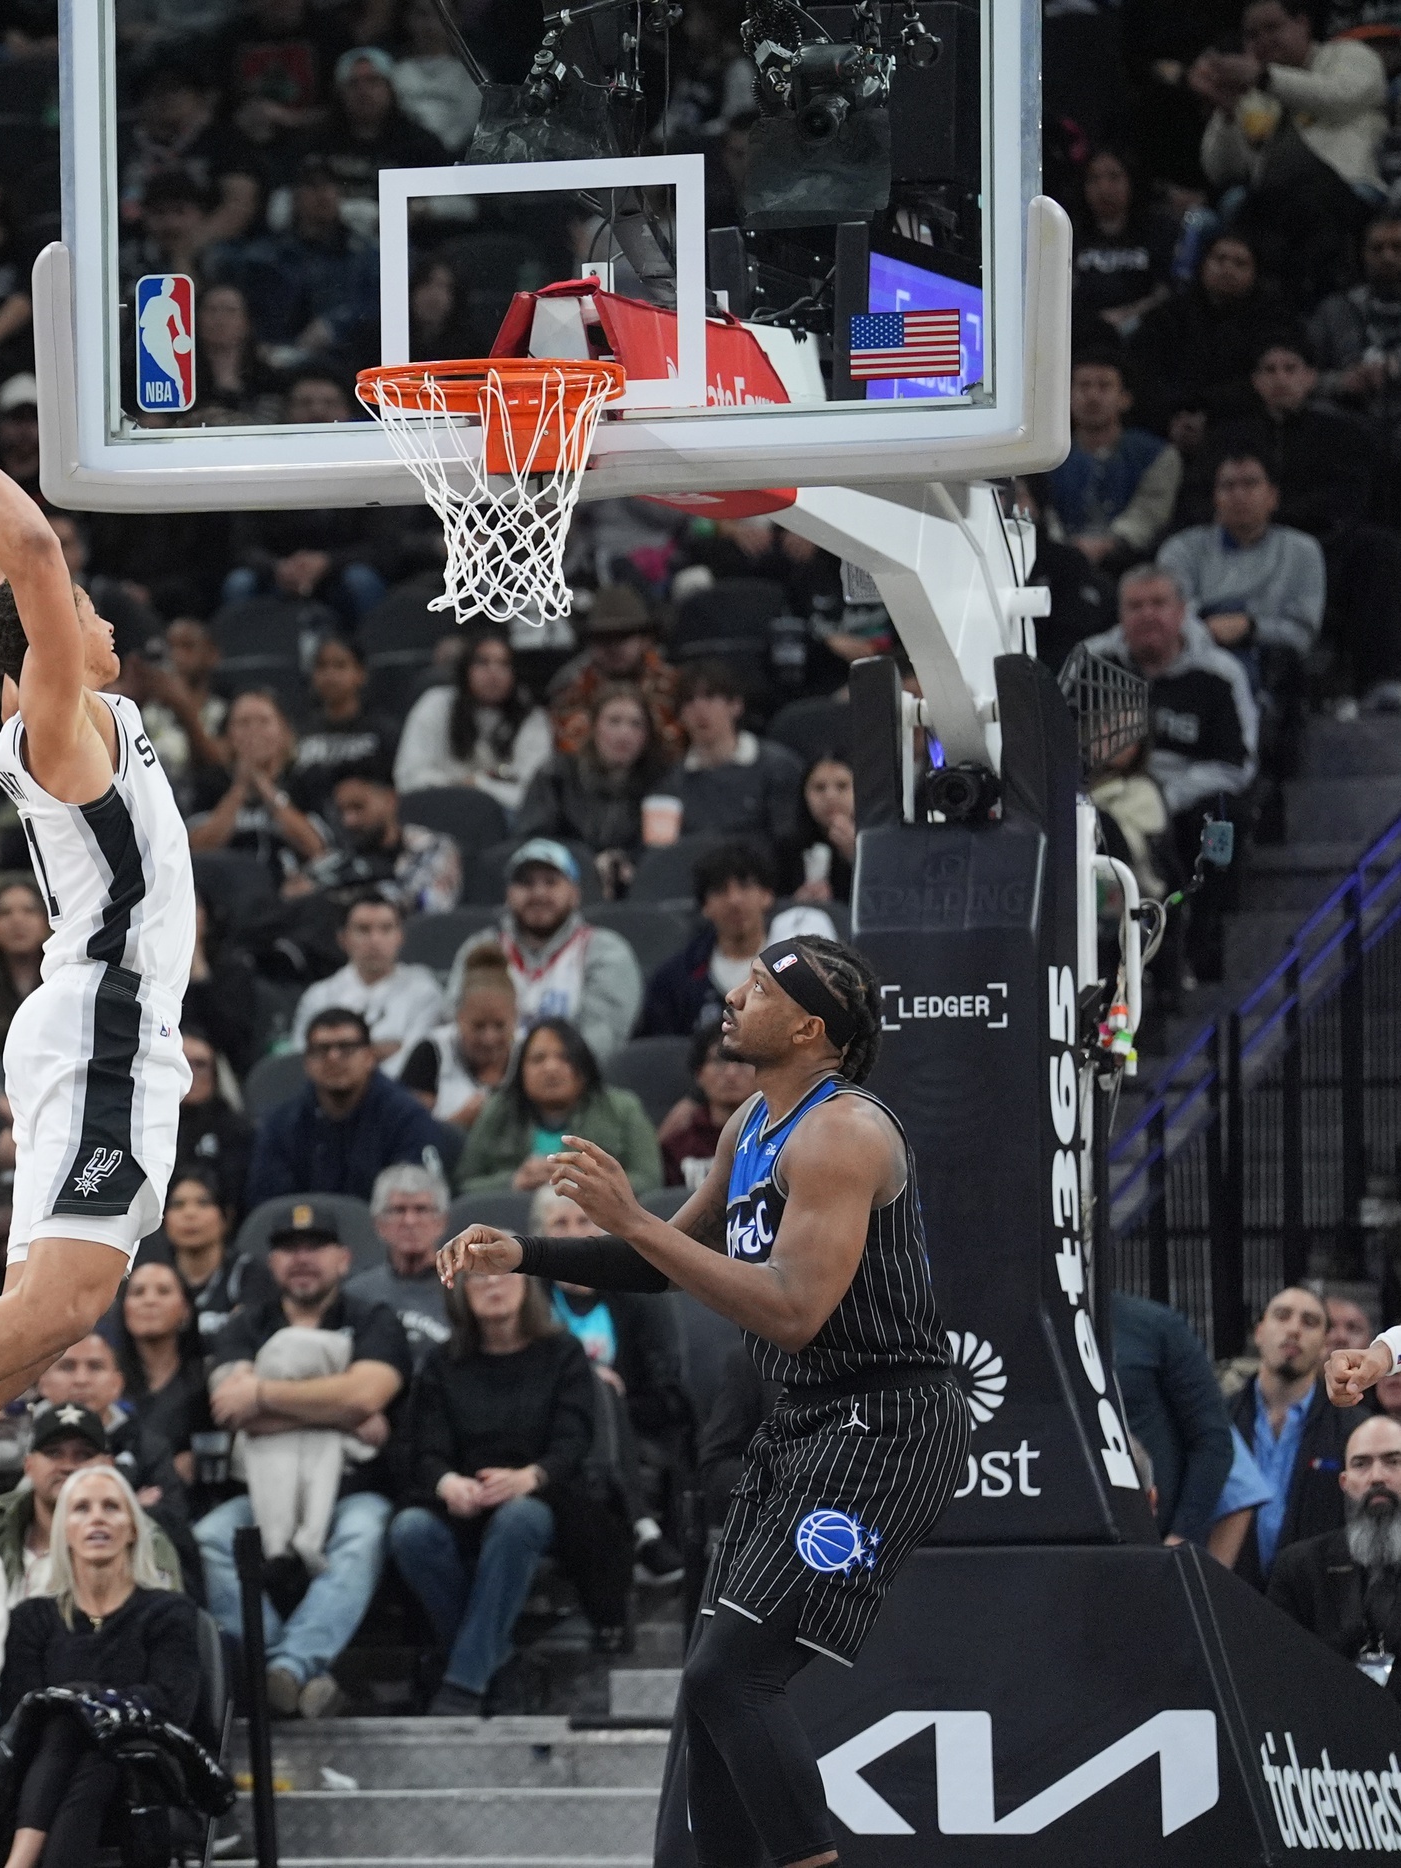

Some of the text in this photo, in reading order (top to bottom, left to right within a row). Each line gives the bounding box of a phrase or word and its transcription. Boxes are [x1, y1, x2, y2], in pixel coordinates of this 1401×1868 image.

[145, 381, 173, 402] NBA
[898, 995, 990, 1019] LEDGER
[1048, 965, 1140, 1489] bet365
